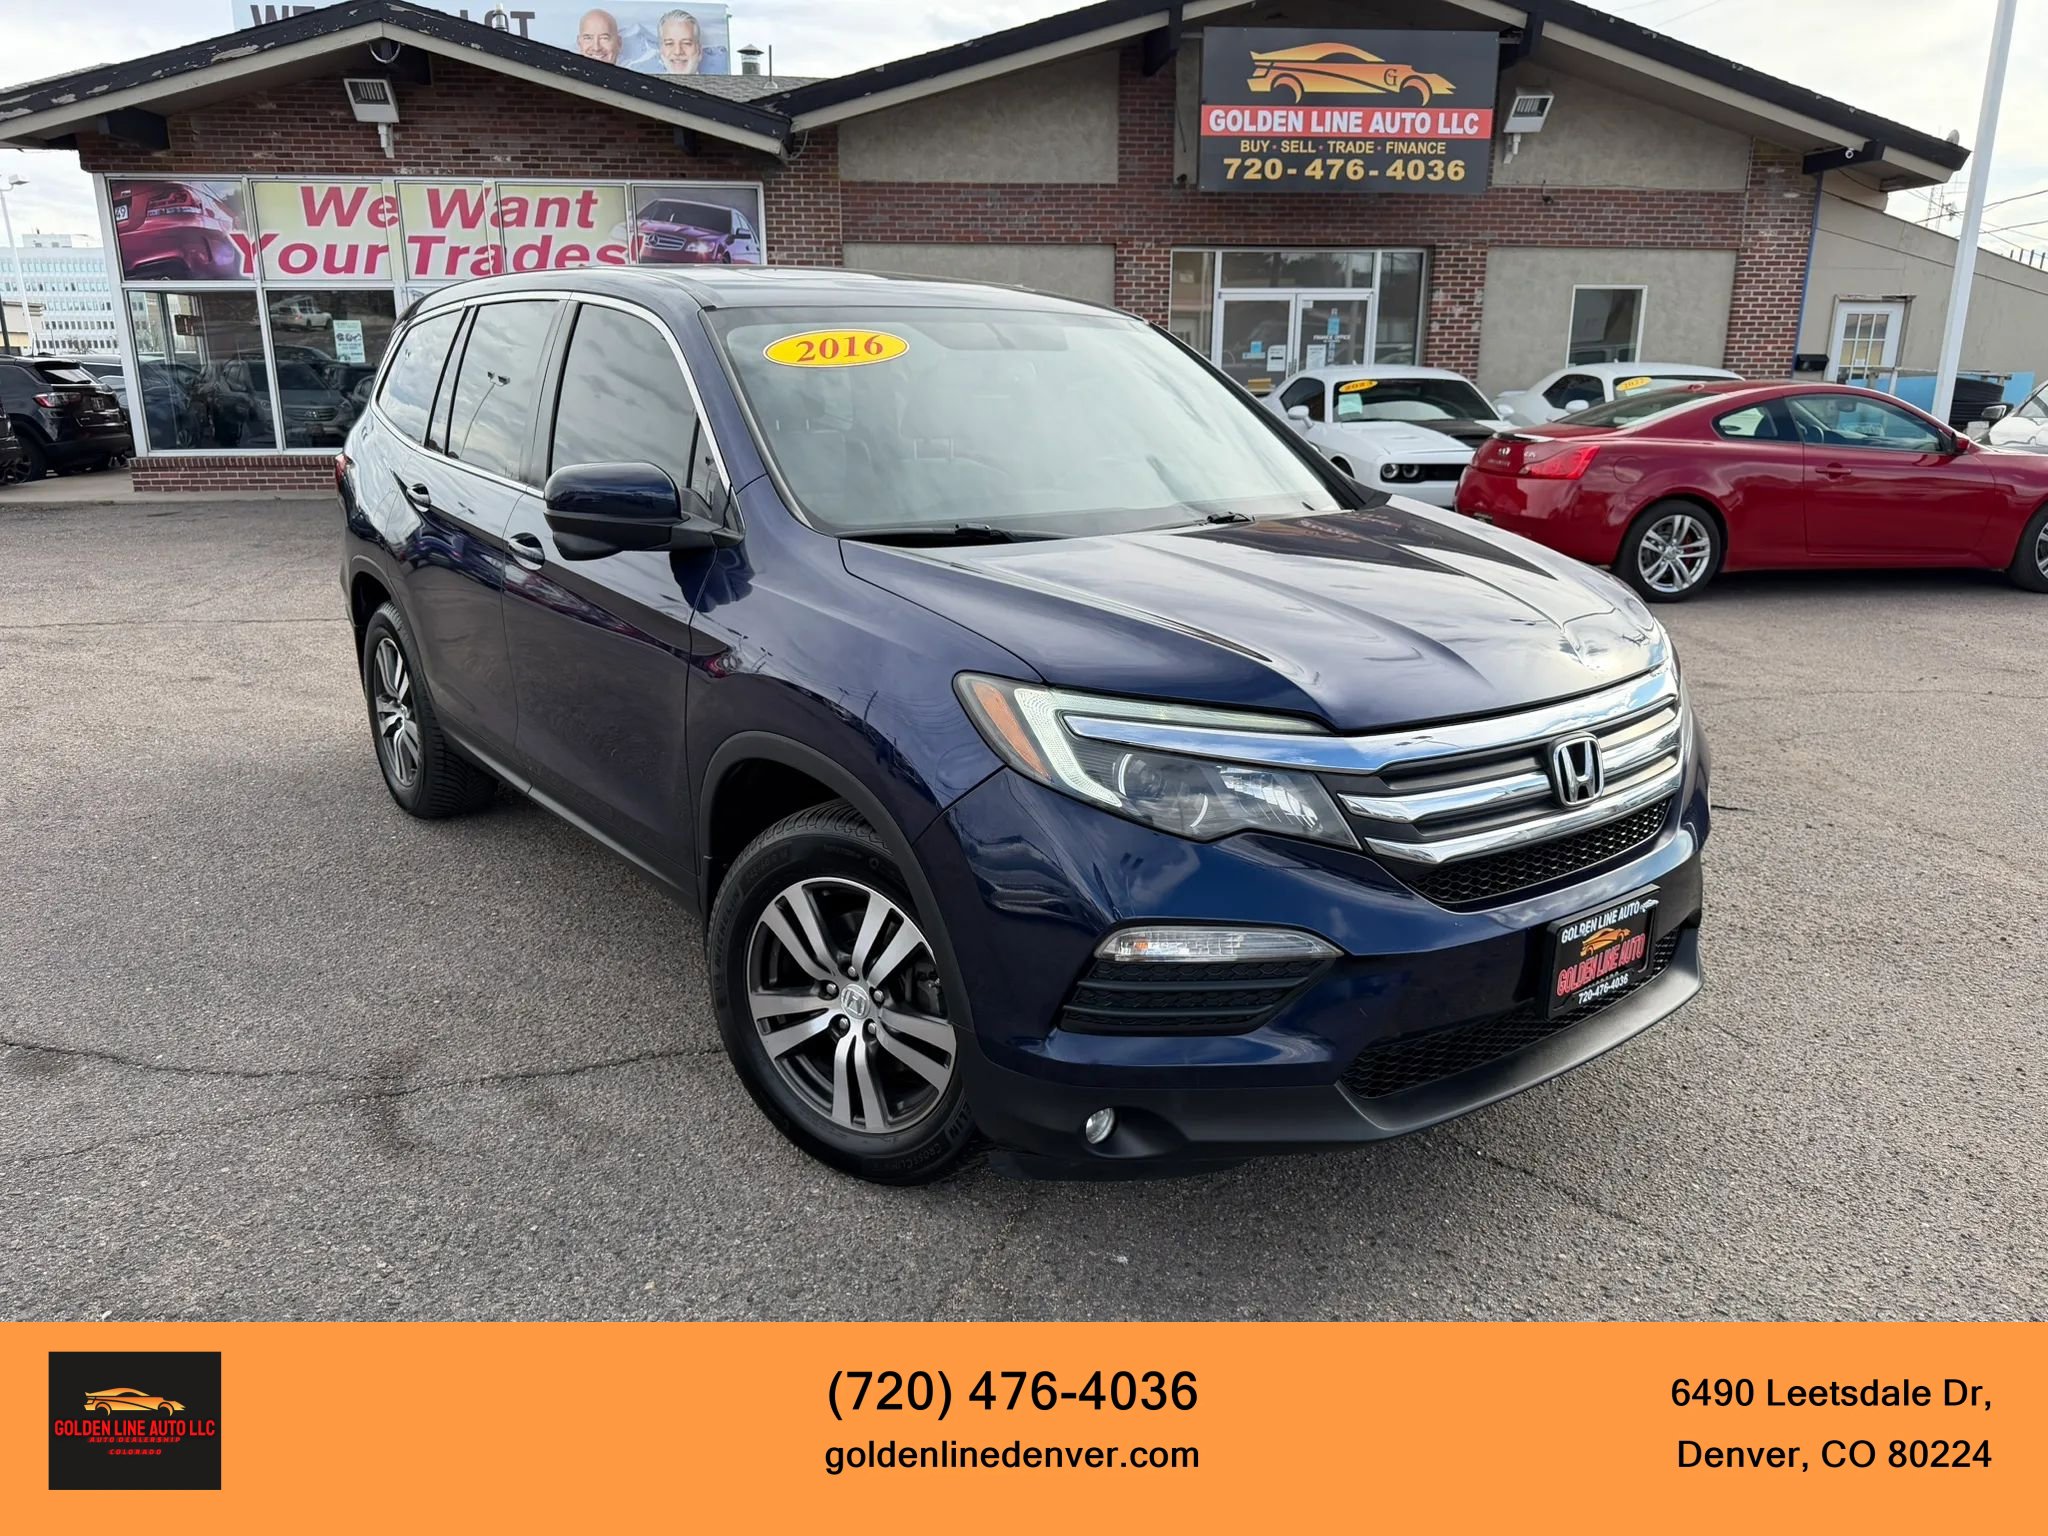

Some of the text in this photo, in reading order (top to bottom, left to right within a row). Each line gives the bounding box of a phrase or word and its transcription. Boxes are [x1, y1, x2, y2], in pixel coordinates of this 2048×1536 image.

[1208, 109, 1480, 135] GOLDEN LINE AUTO LLC
[1240, 140, 1446, 155] BUY SELL TRADE FINANCE
[300, 185, 600, 229] We Want
[231, 232, 390, 275] Your
[795, 335, 883, 362] 2016
[1561, 900, 1640, 944] GOLDEN LINE AUTO
[1556, 933, 1647, 998] GOLDEN LINE AUTO
[1578, 973, 1629, 1005] 720-476-4036
